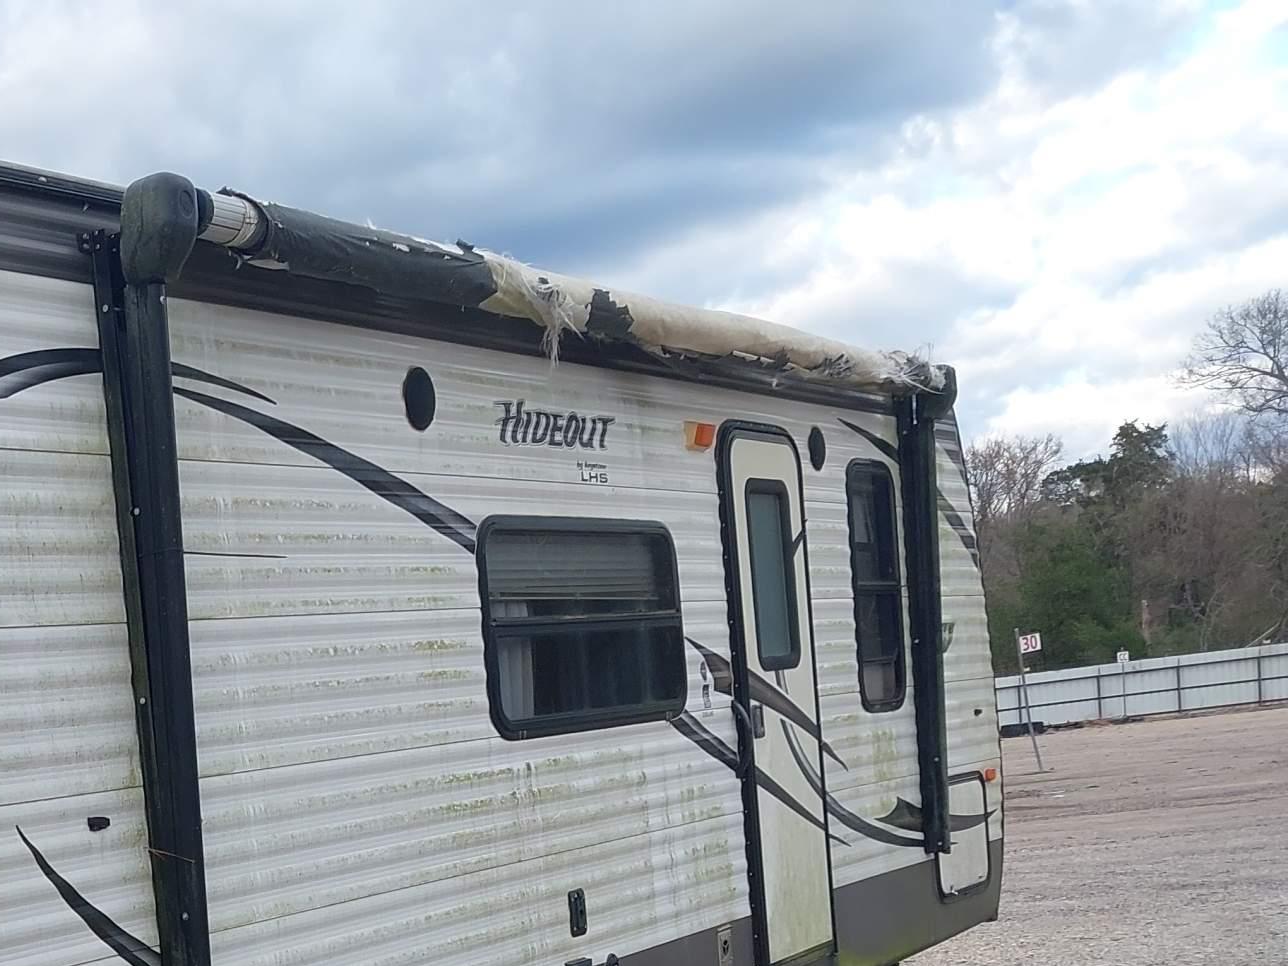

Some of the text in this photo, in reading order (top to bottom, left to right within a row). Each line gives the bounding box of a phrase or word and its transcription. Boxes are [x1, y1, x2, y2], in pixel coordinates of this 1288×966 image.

[494, 400, 615, 450] HIDEOUT
[581, 471, 608, 483] LHS
[1021, 635, 1038, 652] 30
